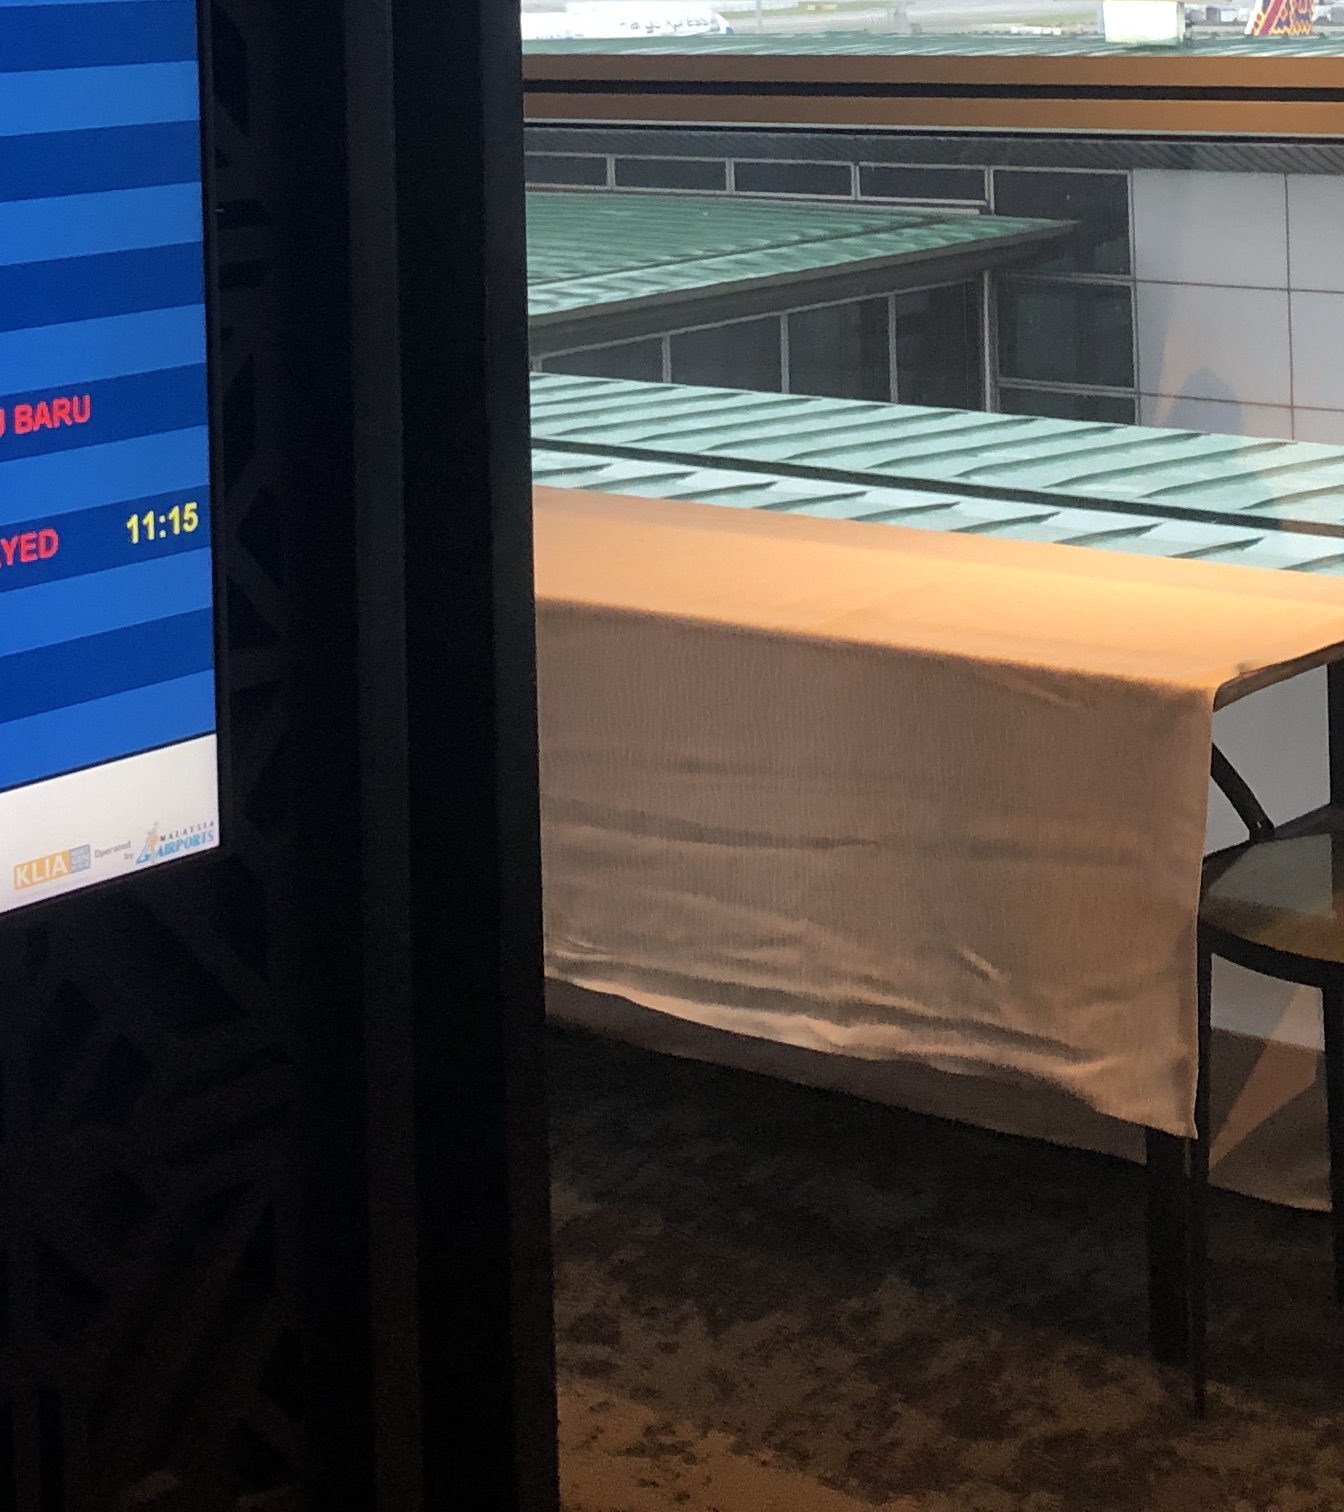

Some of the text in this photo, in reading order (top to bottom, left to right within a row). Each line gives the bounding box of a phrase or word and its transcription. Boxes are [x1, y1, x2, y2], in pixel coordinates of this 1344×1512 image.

[14, 395, 91, 434] BARU
[126, 502, 199, 544] 11:15
[158, 830, 214, 857] AIRPORTS
[16, 855, 68, 887] KLIA
